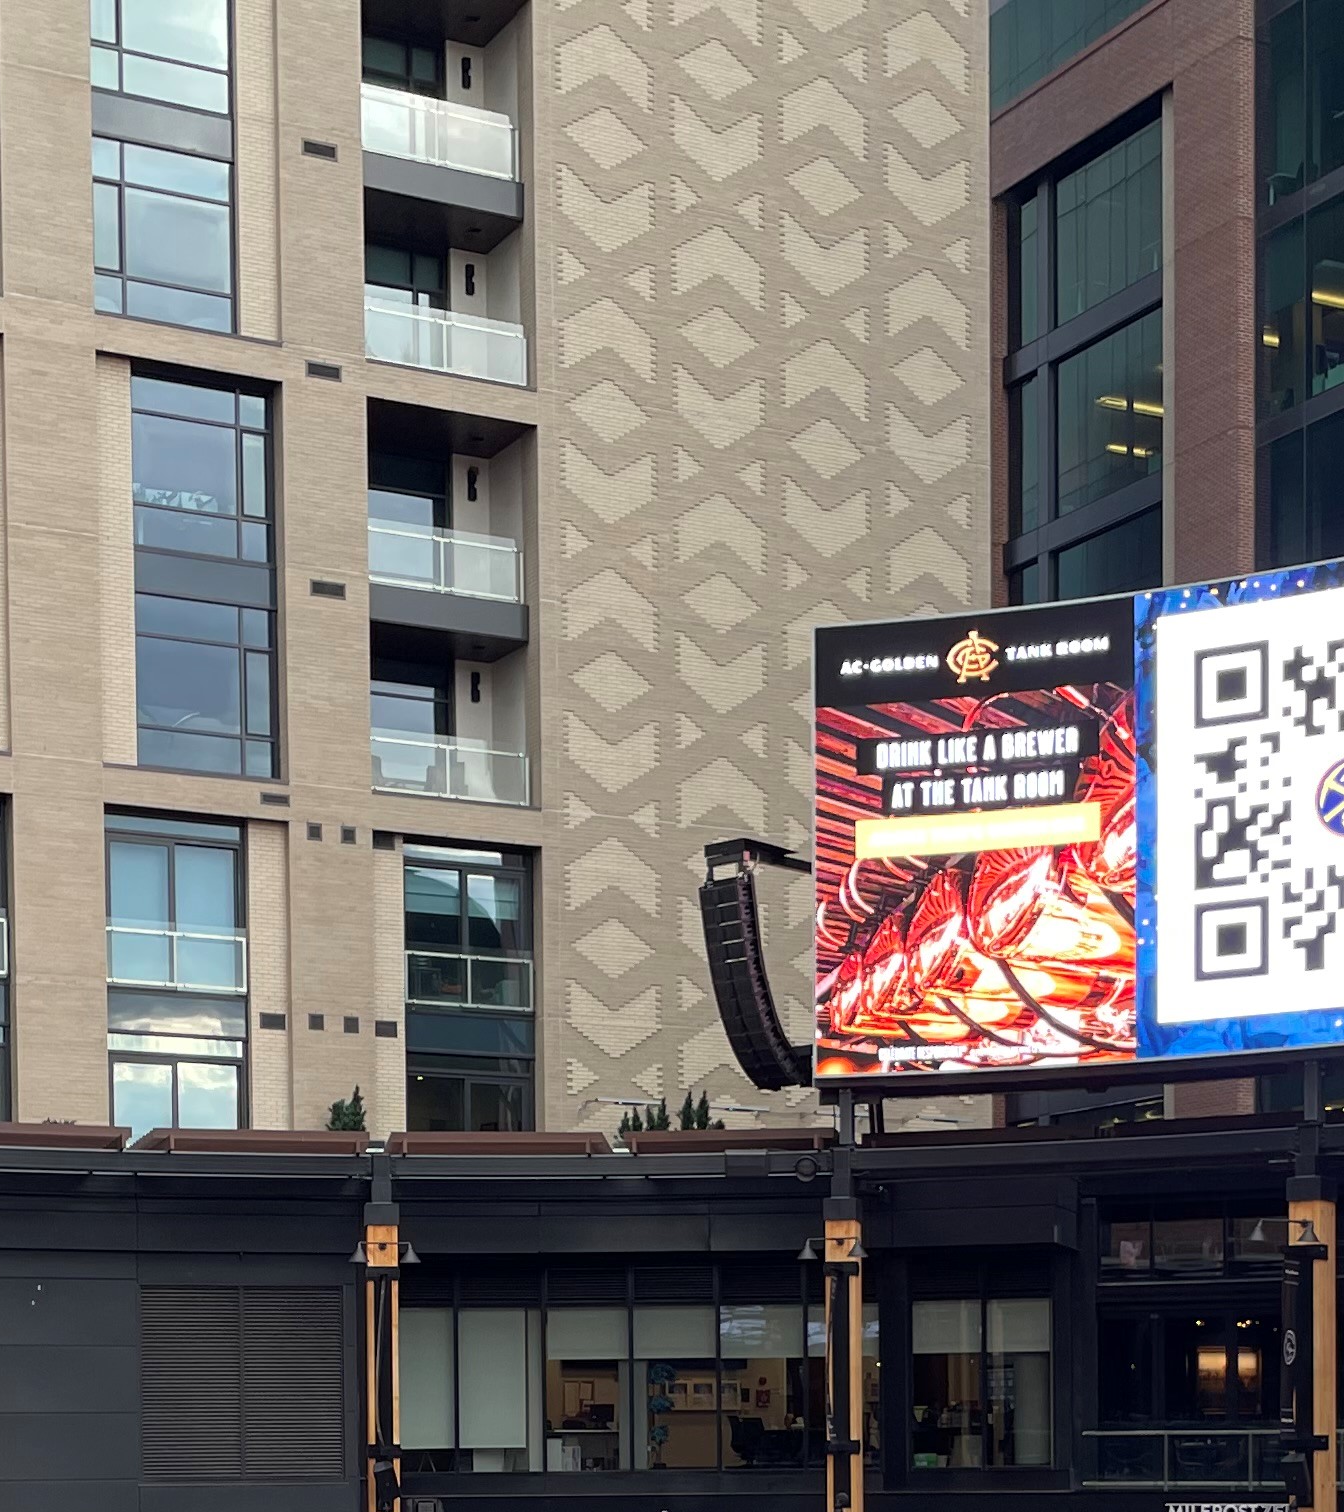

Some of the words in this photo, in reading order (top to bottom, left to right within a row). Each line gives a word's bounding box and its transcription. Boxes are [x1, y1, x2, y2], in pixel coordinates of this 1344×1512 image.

[1005, 644, 1052, 662] TANK
[1057, 637, 1108, 654] ROOM
[876, 741, 931, 770] DRINK
[938, 736, 976, 765] LIKE
[983, 735, 995, 760] A
[1002, 727, 1079, 758] BREWER
[891, 783, 913, 809] AT
[922, 778, 955, 807] THE
[960, 774, 1007, 802] TANK
[1013, 771, 1064, 798] ROOM
